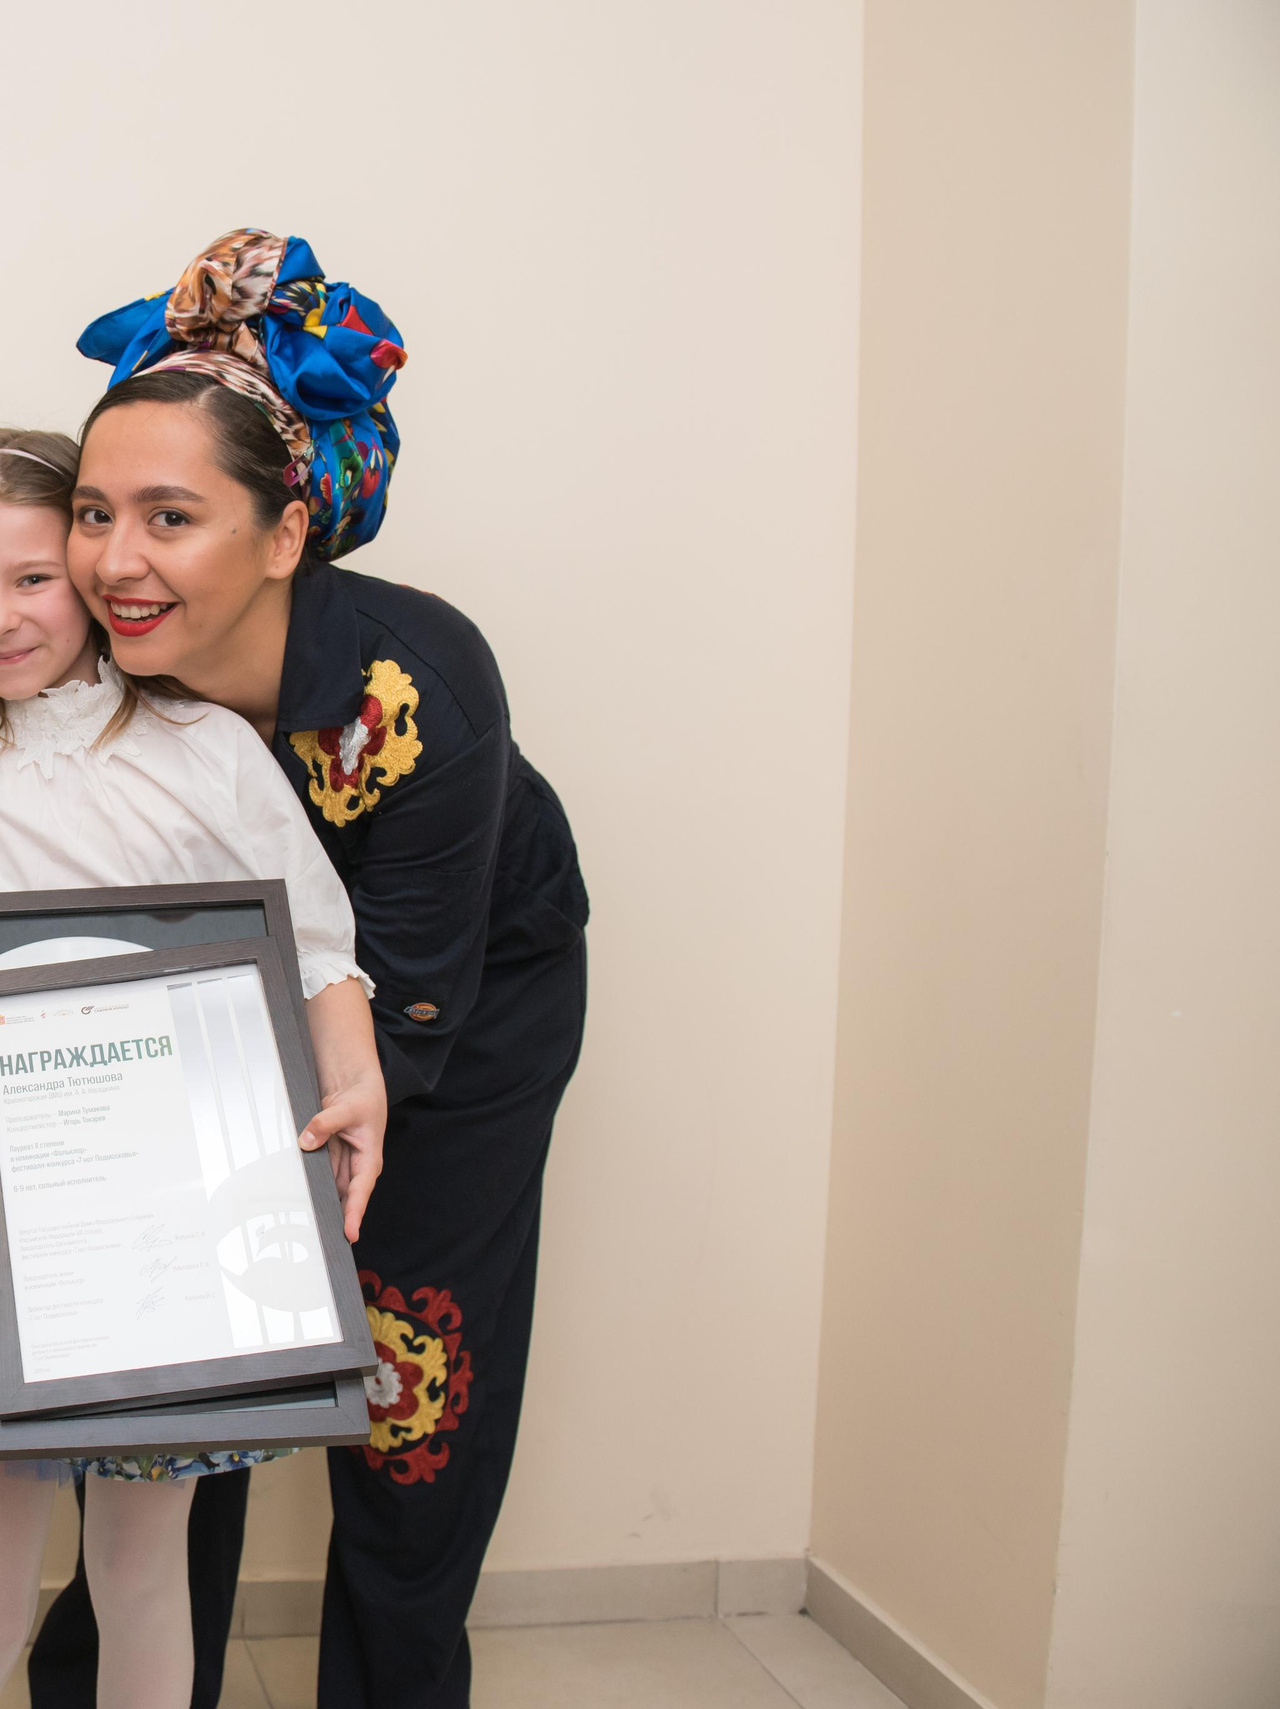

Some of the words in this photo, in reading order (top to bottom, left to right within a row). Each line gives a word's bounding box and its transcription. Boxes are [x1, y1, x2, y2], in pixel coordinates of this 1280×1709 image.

[0, 1035, 173, 1077] НАГРАЖДАЕТСЯ
[2, 1080, 65, 1095] Александра
[67, 1073, 123, 1088] Тютюшова
[58, 1108, 81, 1118] Марина
[82, 1104, 110, 1116] Тумакова
[63, 1117, 81, 1127] Игорь
[82, 1114, 106, 1124] Токарев
[9, 1142, 34, 1154] Лауреат
[40, 1140, 65, 1150] степени
[15, 1151, 50, 1163] номинации
[13, 1184, 24, 1193] 6-9
[38, 1179, 66, 1190] сольный
